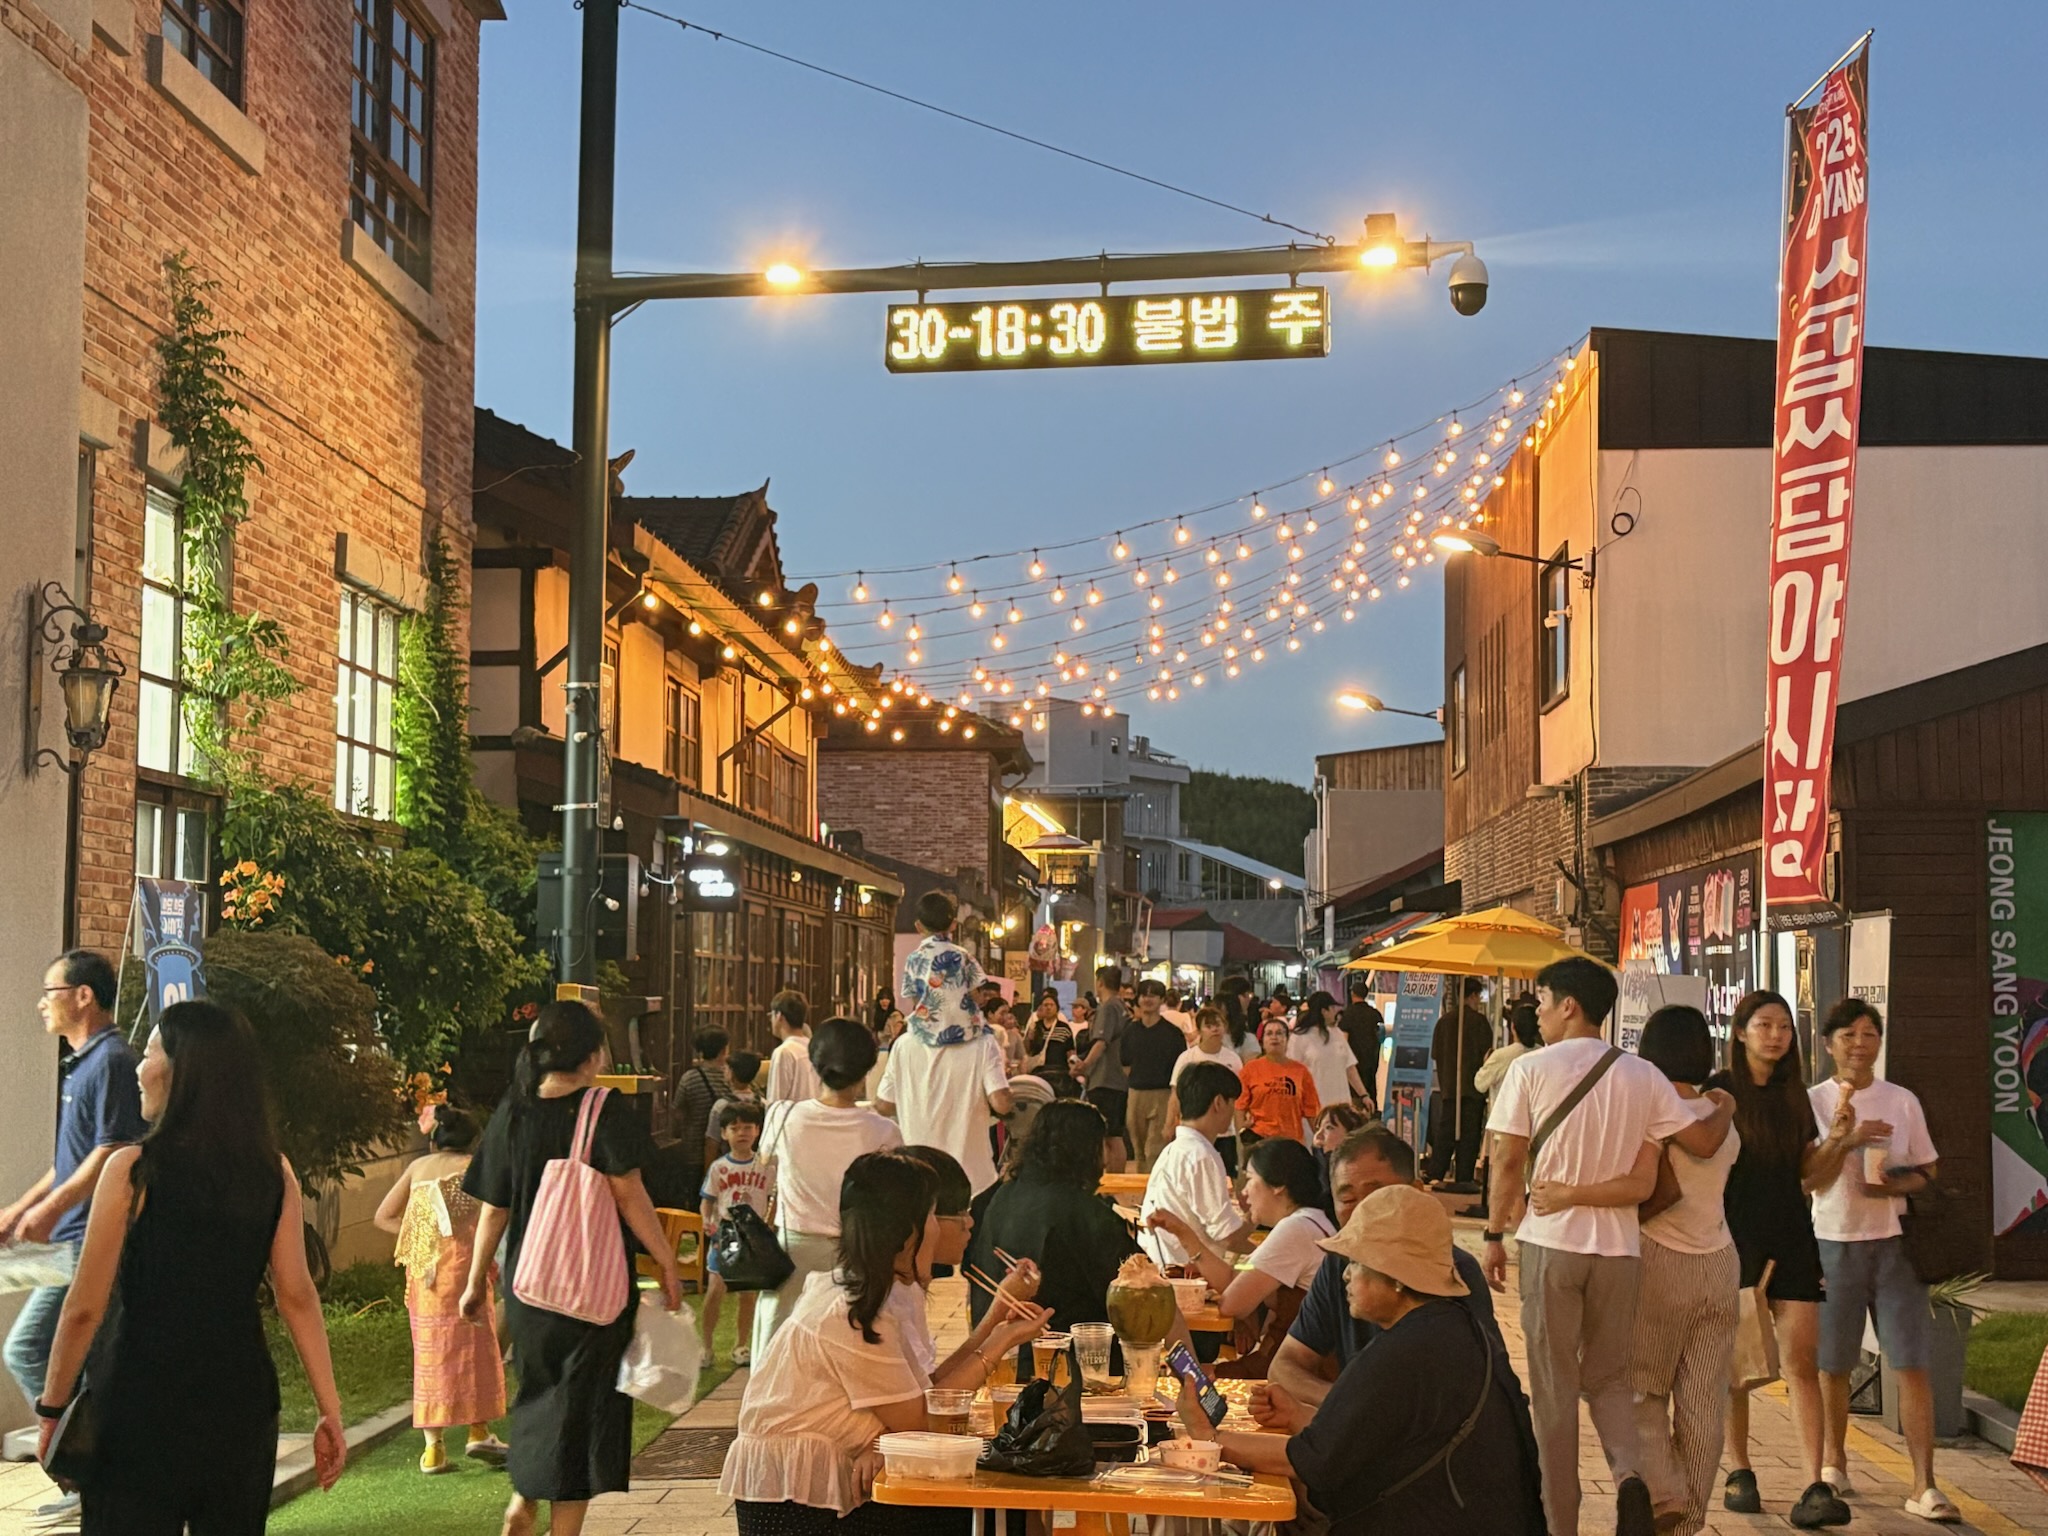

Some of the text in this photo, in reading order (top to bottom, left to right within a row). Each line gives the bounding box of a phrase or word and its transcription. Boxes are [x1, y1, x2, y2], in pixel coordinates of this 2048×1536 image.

[1133, 296, 1238, 352] 불법
[1267, 292, 1322, 346] 주
[1987, 818, 2020, 1114] JEONG SANG YOON
[1085, 1355, 1108, 1366] TERRA
